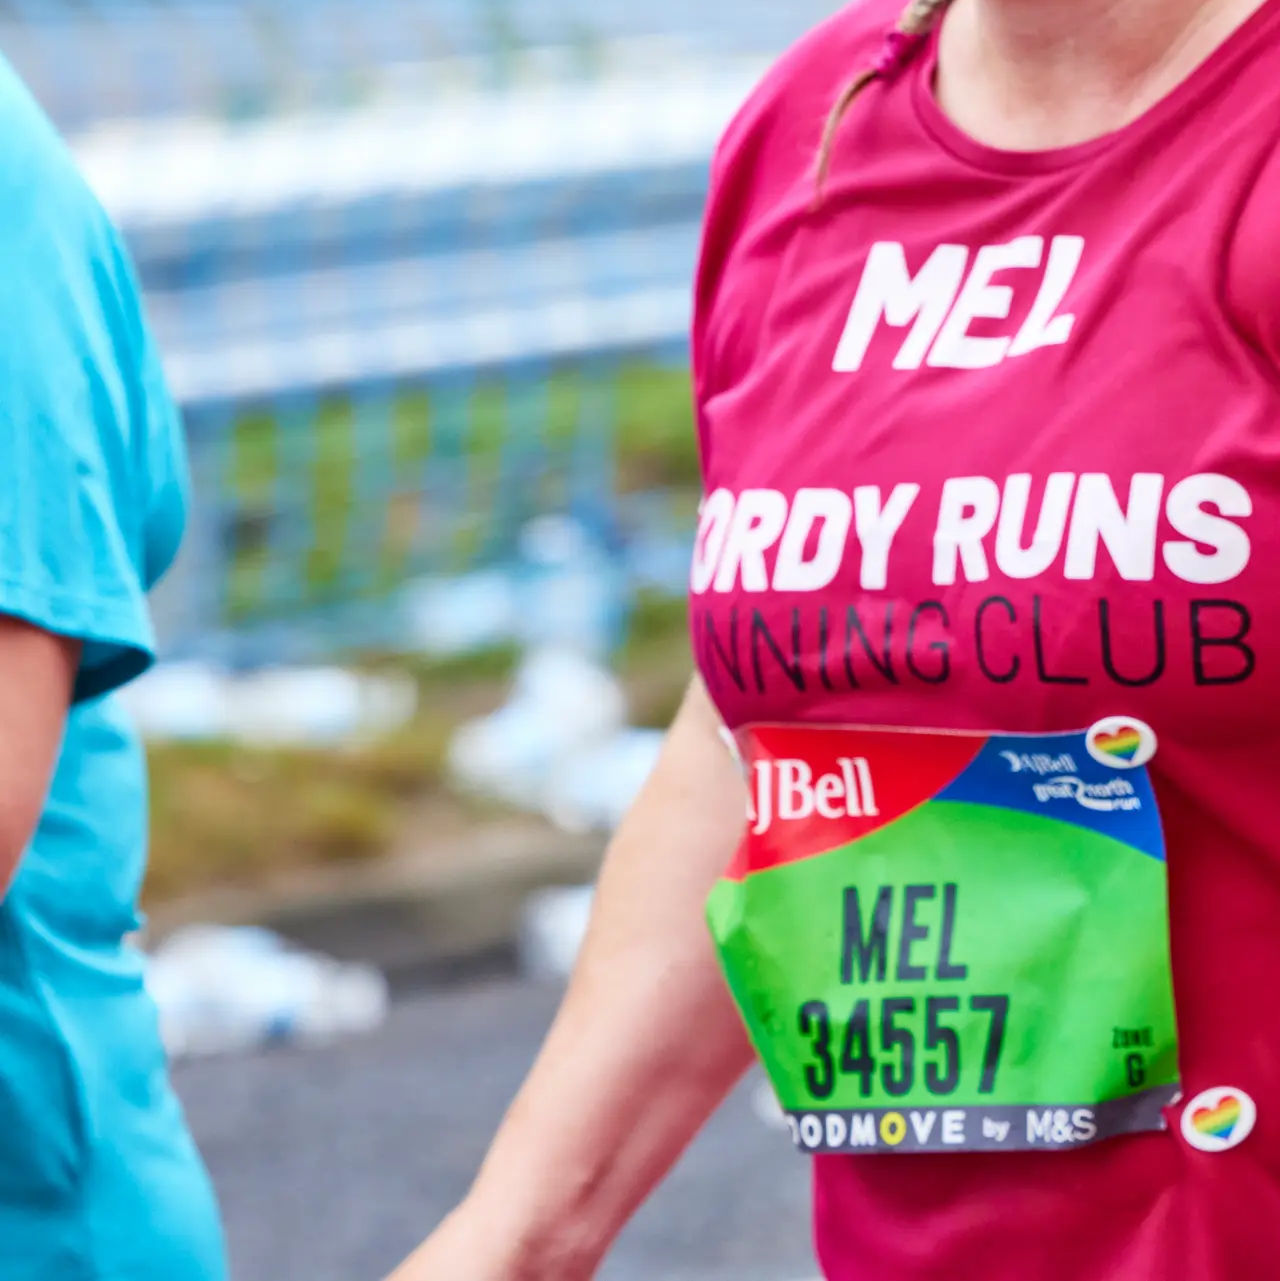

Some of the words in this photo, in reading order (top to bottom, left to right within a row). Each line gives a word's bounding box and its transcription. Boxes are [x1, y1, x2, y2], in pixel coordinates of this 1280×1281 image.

[831, 234, 1085, 373] MEL
[690, 481, 920, 595] ORDY
[931, 471, 1253, 585] RUNS
[699, 599, 951, 694] NNING
[973, 593, 1257, 688] CLUB
[746, 756, 880, 836] JBell
[840, 881, 968, 985] MEL
[798, 993, 1011, 1101] 34557
[981, 1116, 1011, 1142] by
[1025, 1108, 1097, 1144] M&S
